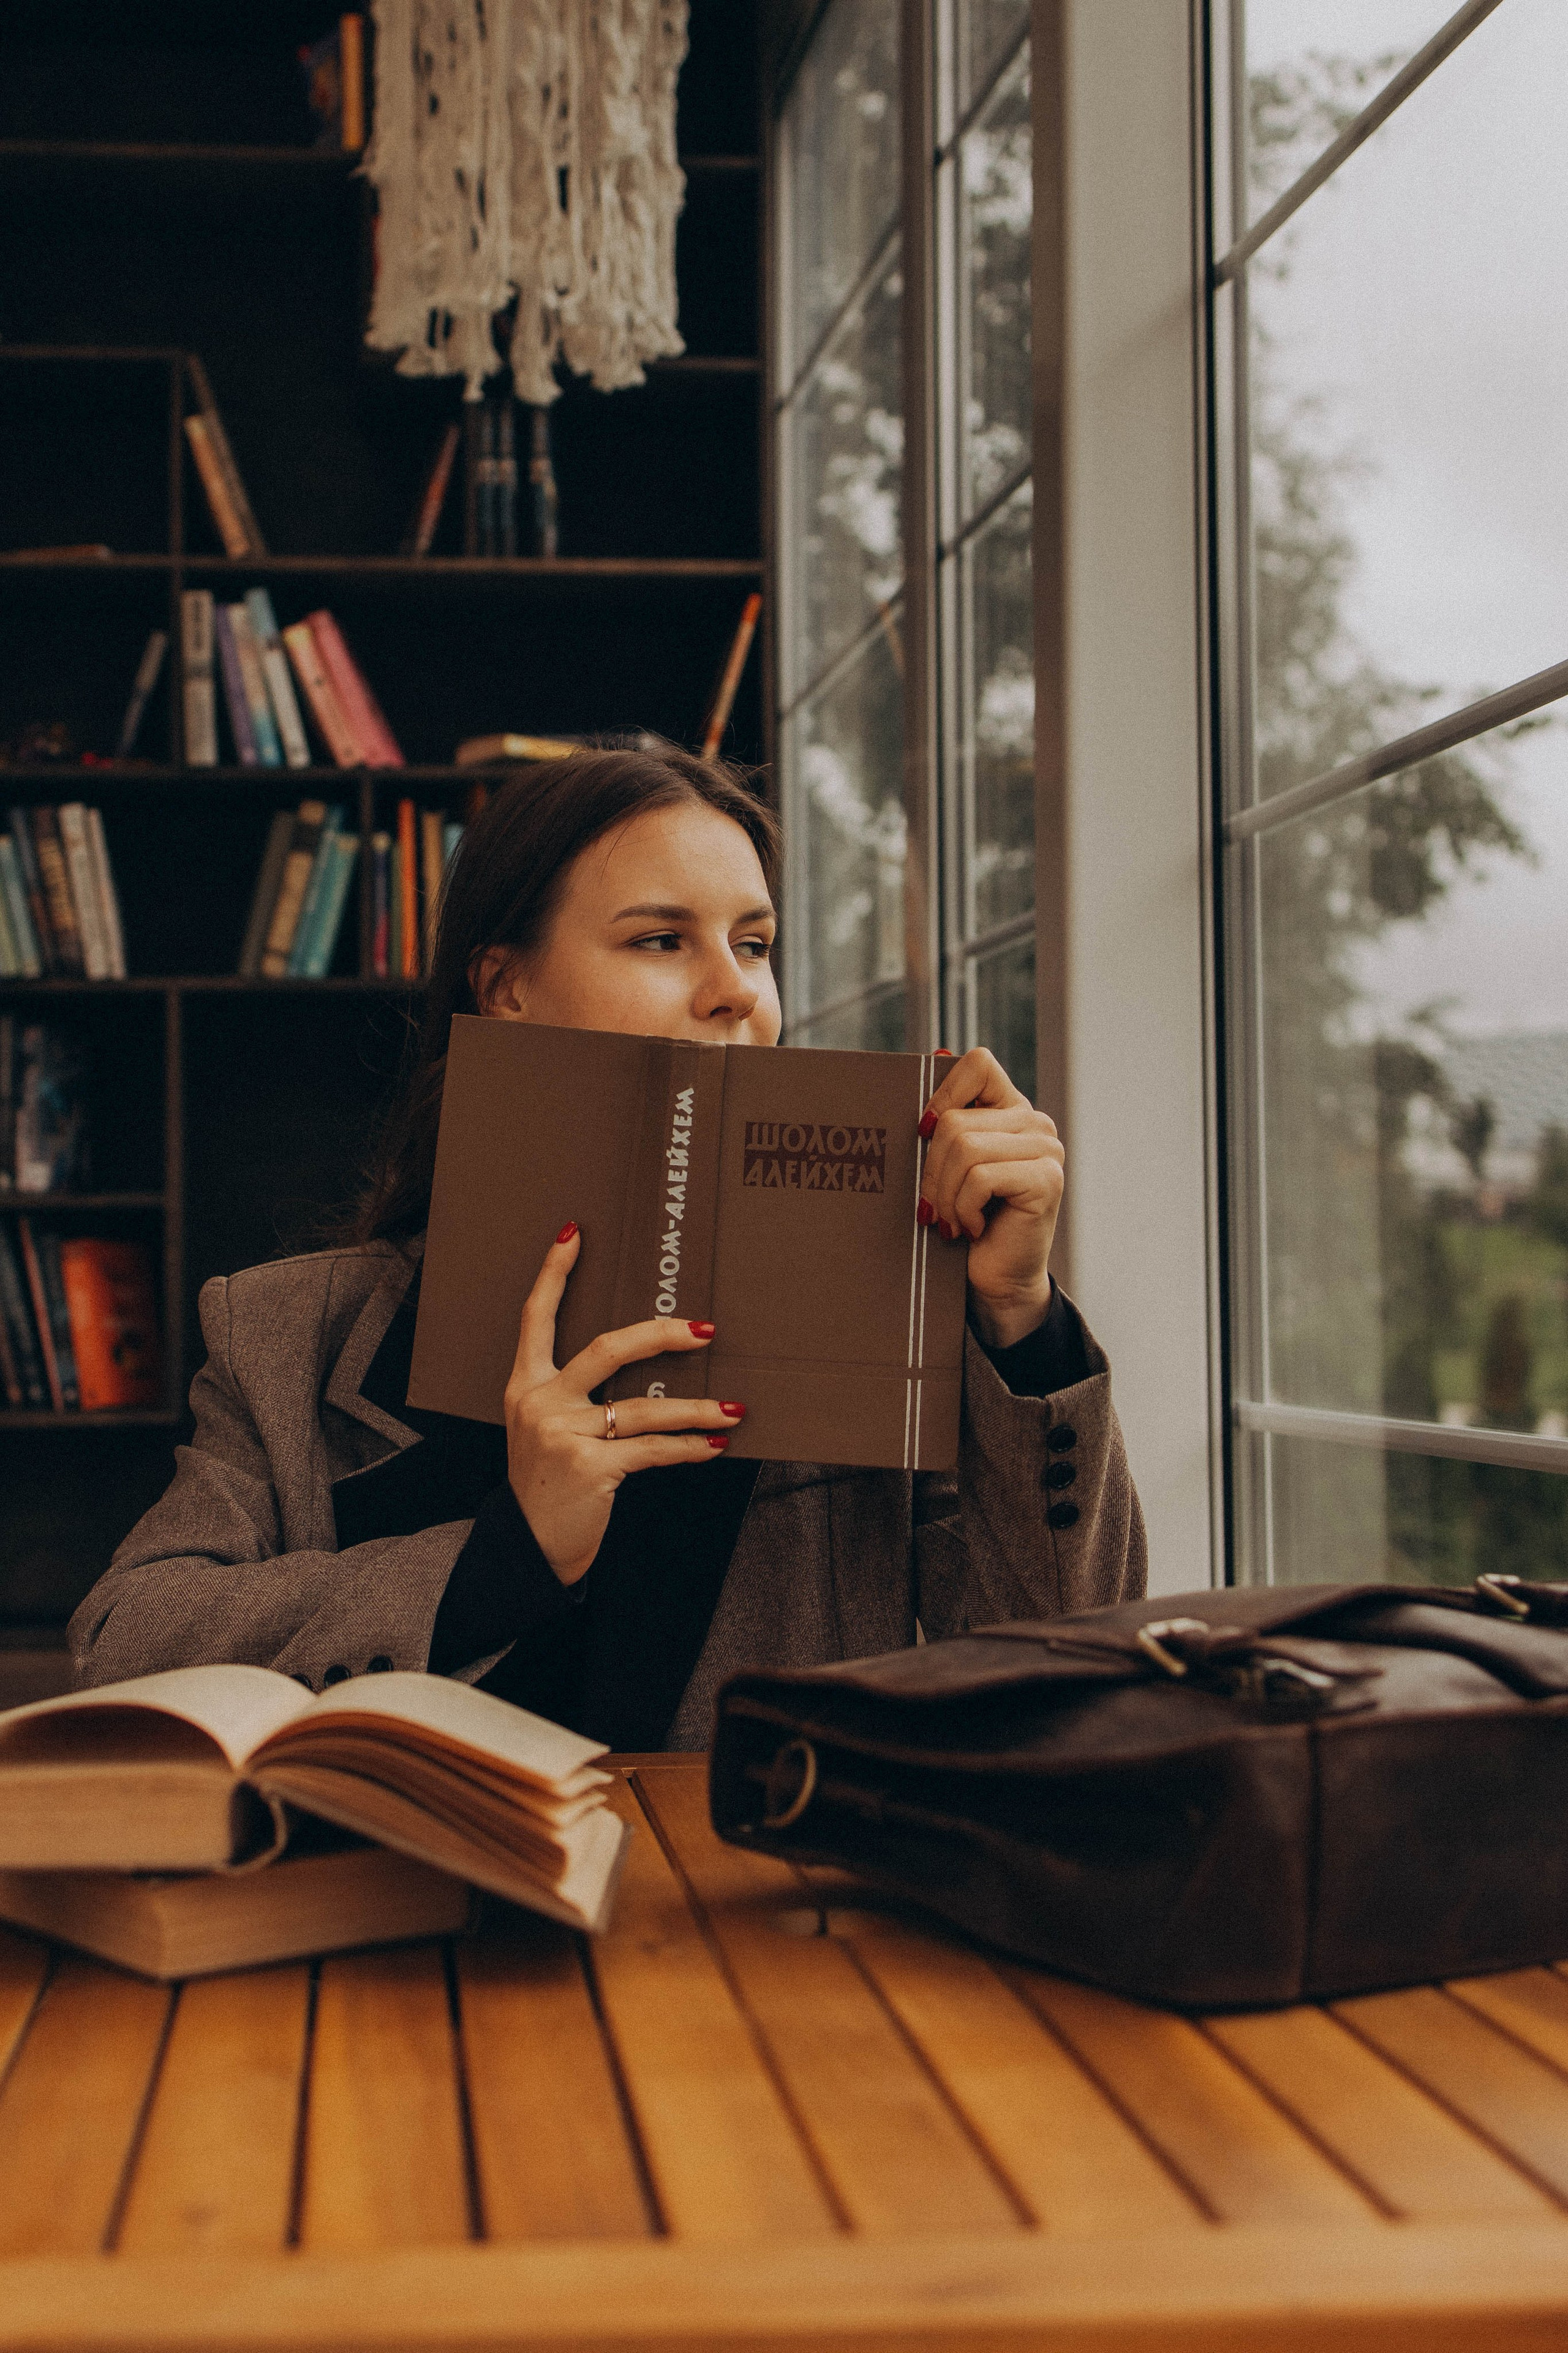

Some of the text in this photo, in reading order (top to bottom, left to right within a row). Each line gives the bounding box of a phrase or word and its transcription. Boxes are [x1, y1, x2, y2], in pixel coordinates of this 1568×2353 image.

[744, 1155, 884, 1192] АЛЕЙХЕМ
[654, 1087, 695, 1320] ОЛОМ-АЛЕЙХЕМ
[647, 1381, 666, 1398] 6
